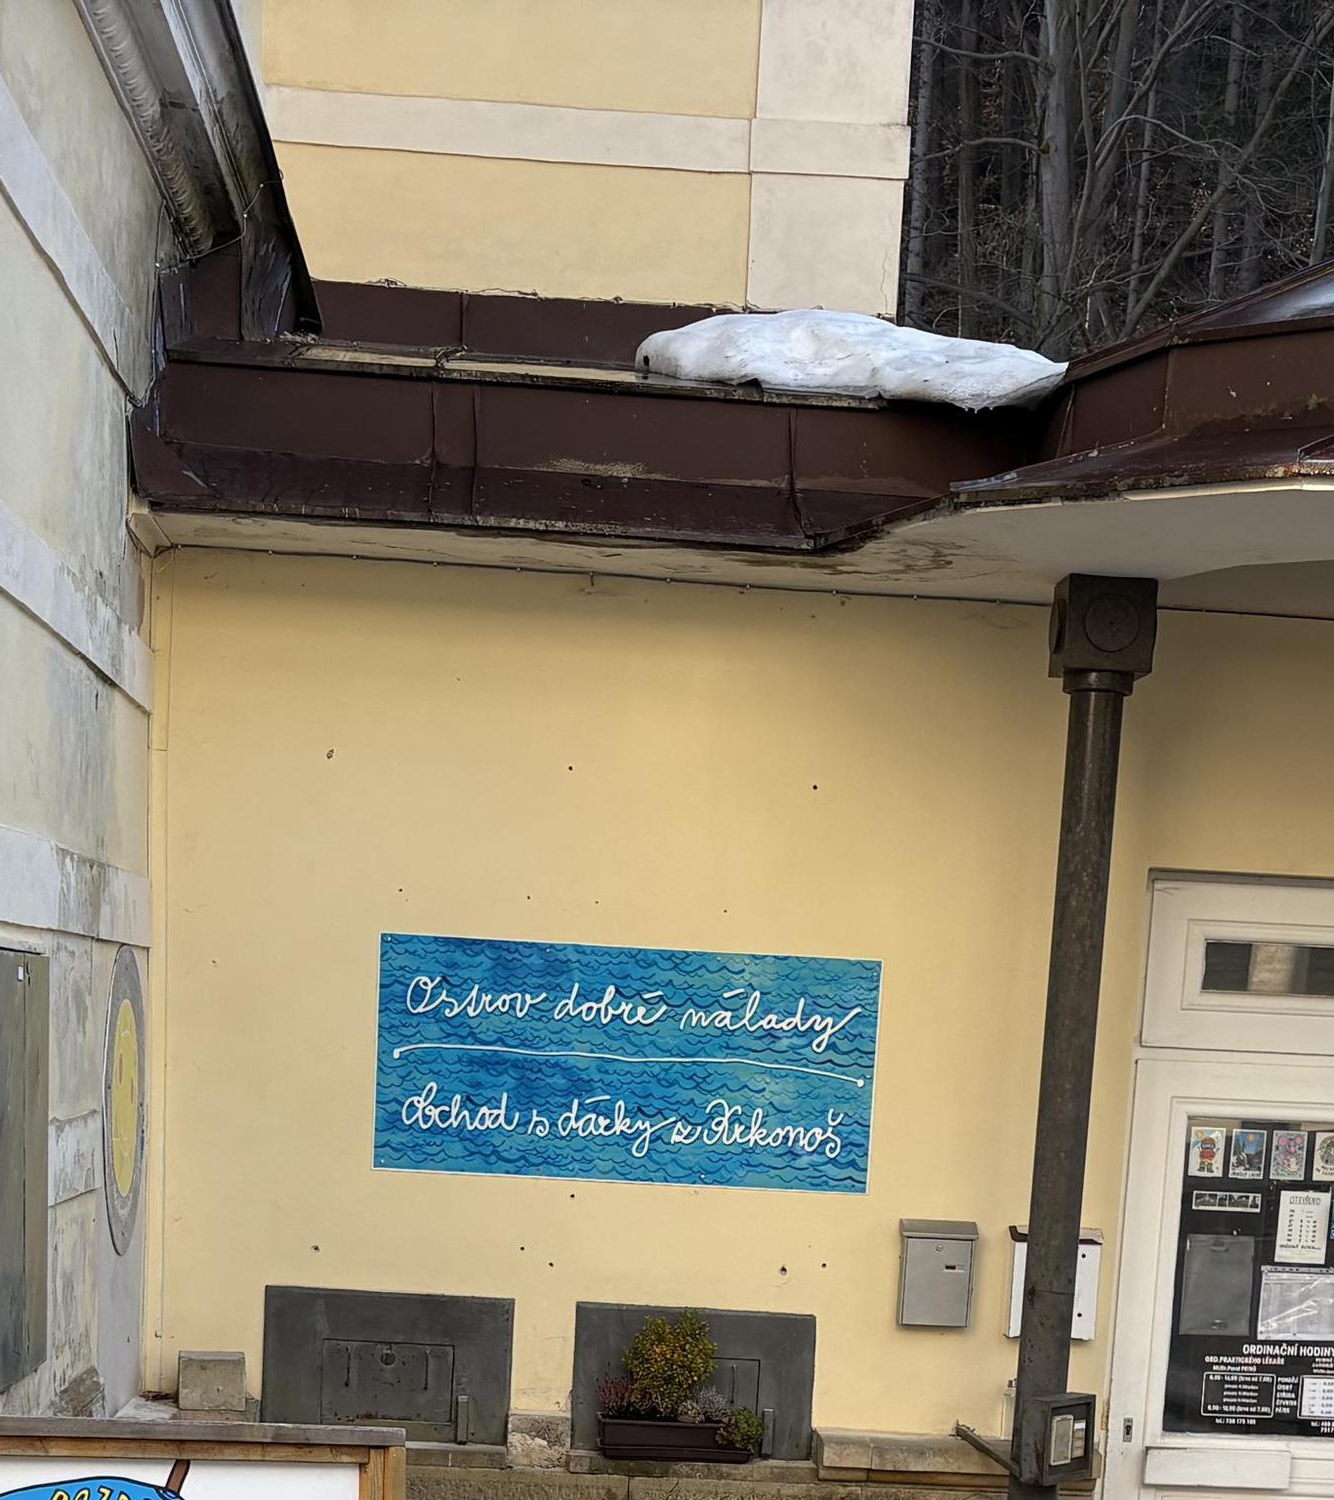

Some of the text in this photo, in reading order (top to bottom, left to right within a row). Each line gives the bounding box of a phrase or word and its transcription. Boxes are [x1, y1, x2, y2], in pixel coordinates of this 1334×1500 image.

[406, 975, 862, 1052] Ostrov dobré nálady
[528, 1108, 552, 1137] s
[558, 1095, 674, 1157] dárky
[701, 1098, 843, 1158] Krkonoš
[1243, 1343, 1298, 1356] ORDINAČNÍ
